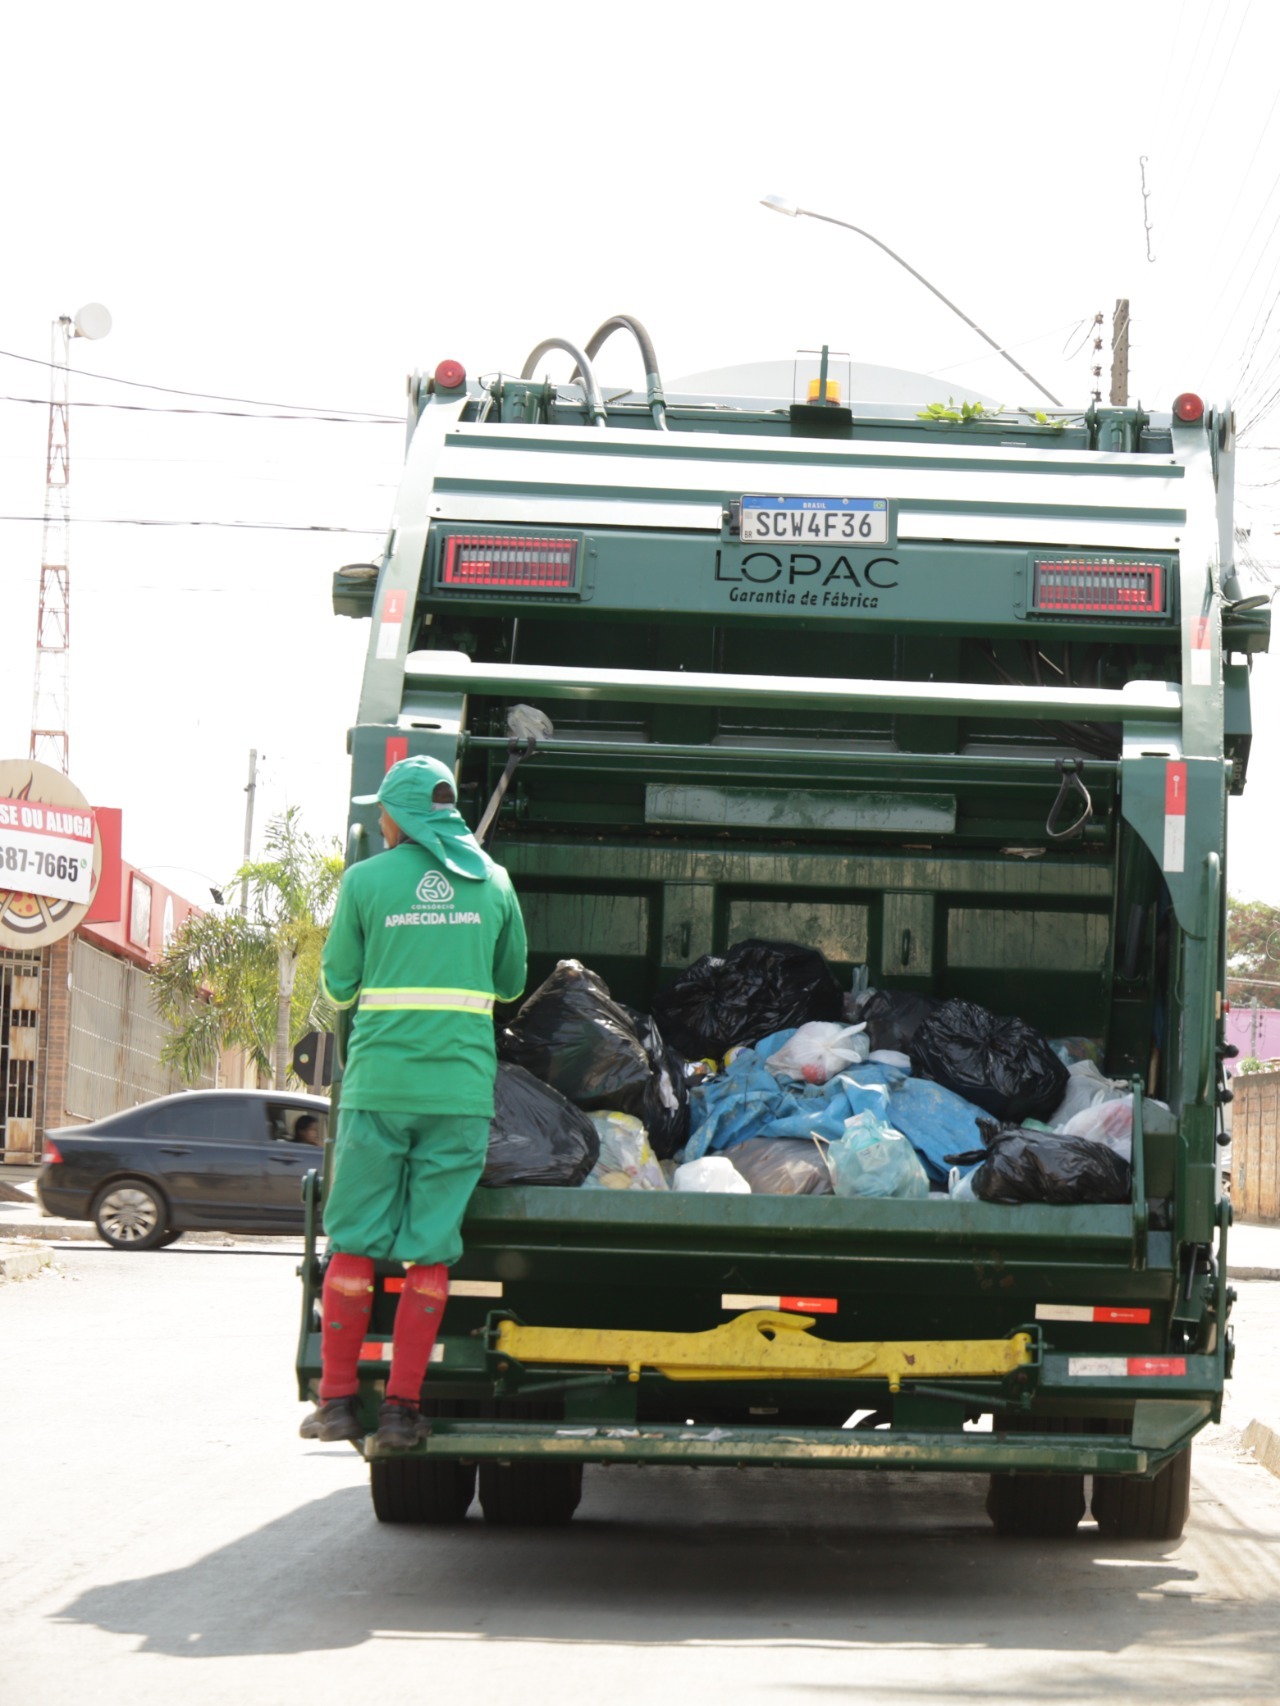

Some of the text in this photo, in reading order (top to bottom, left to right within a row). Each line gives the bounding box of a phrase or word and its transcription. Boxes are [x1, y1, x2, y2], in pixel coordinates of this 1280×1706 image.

[744, 530, 753, 539] BR
[756, 511, 872, 538] SCW4F36
[714, 549, 900, 589] LOPAC
[729, 586, 879, 609] Garantia de Fábrica
[21, 806, 44, 830] OU
[46, 811, 92, 839] ALUGA
[384, 911, 482, 928] APARECIDA LIMPA
